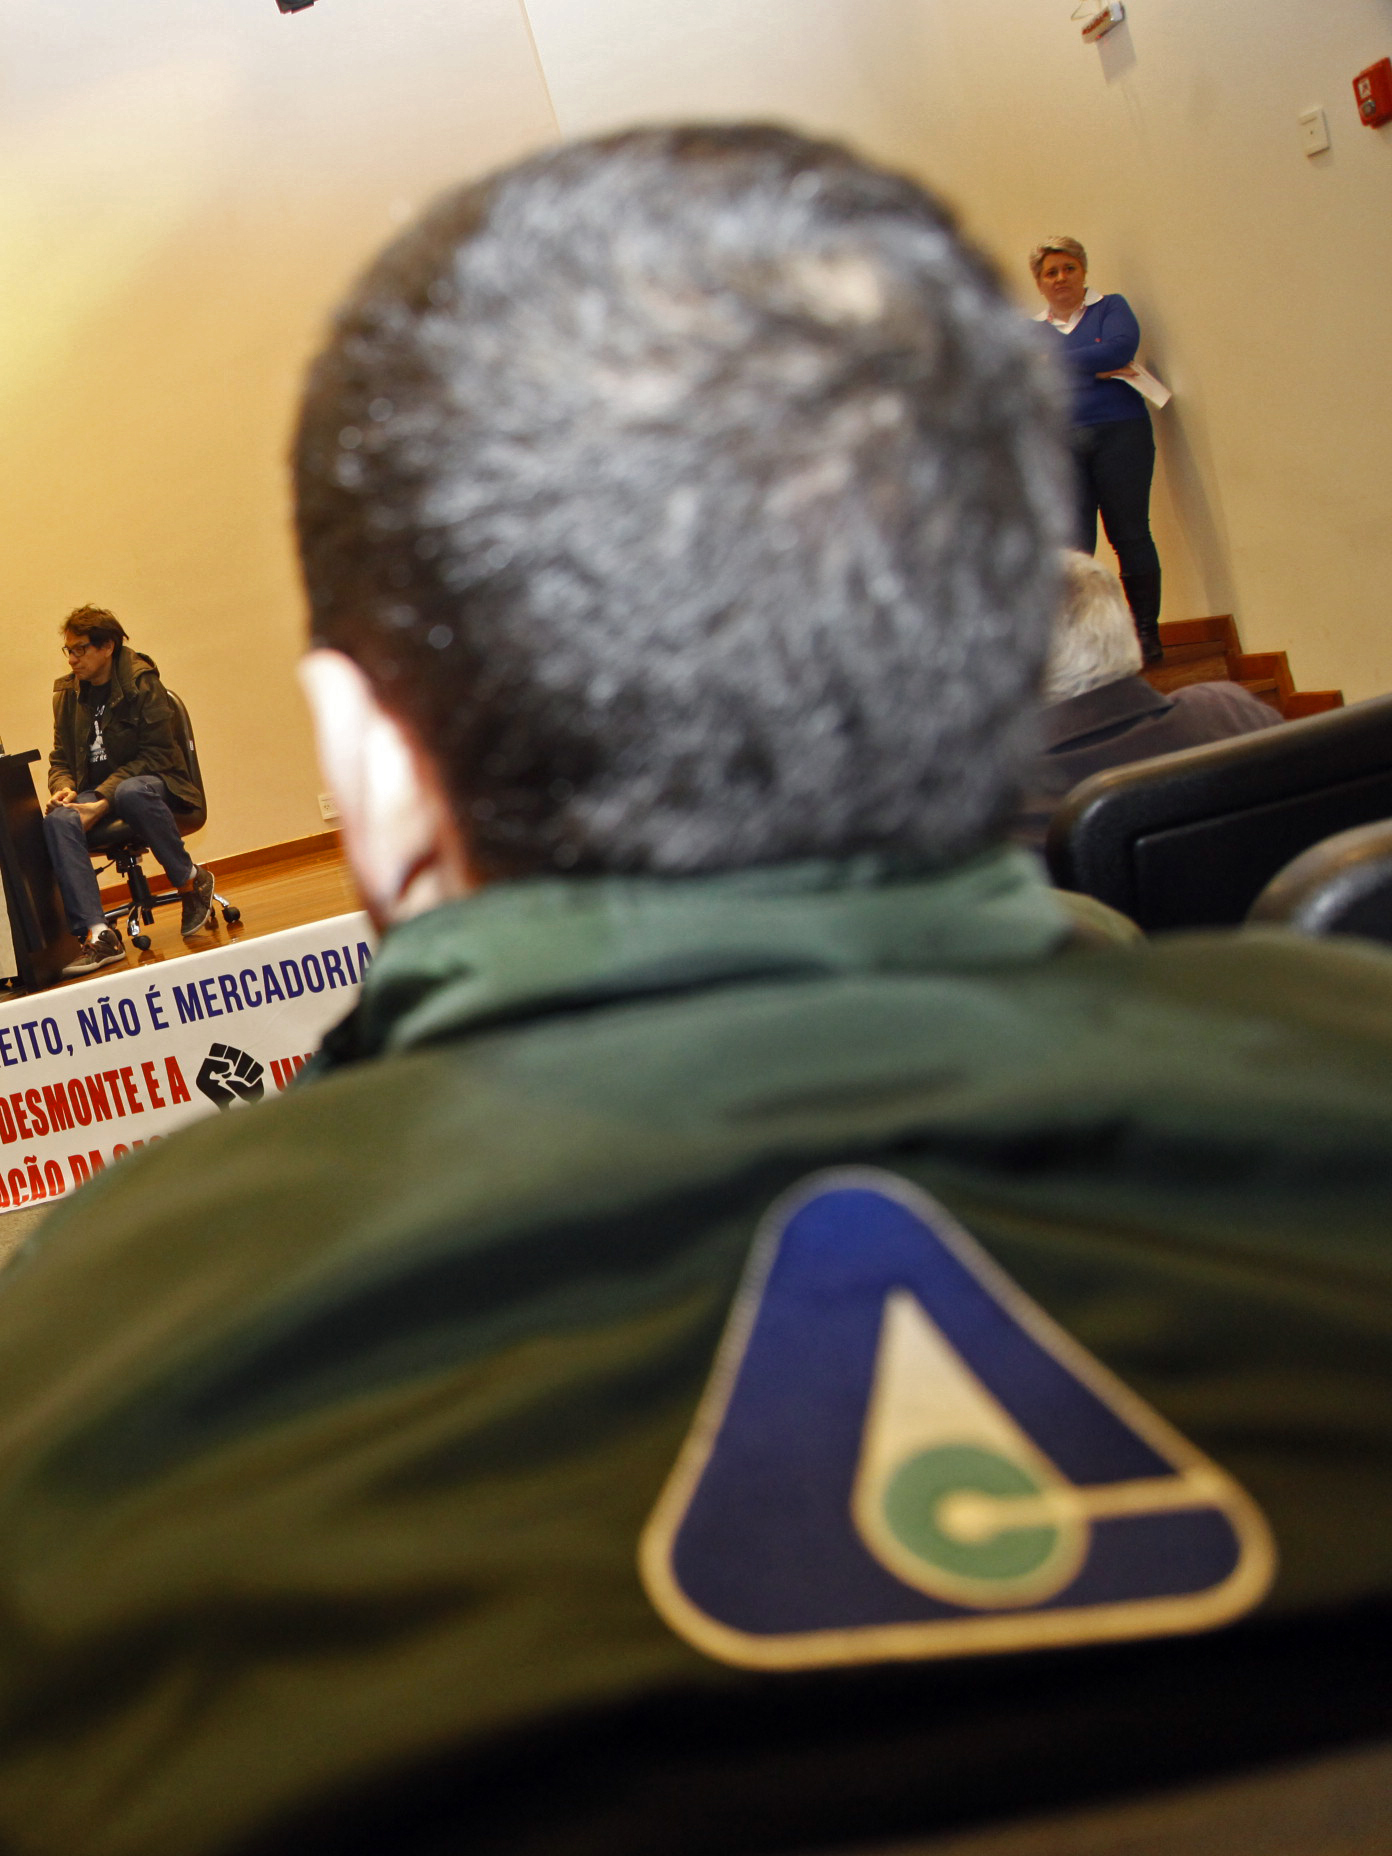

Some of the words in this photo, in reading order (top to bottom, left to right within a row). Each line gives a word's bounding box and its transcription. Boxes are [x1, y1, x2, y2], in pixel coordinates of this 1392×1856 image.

[76, 995, 141, 1047] NÃO
[145, 984, 170, 1031] É
[172, 941, 375, 1024] MERCADORIA
[140, 1060, 167, 1110] E
[164, 1055, 192, 1105] A
